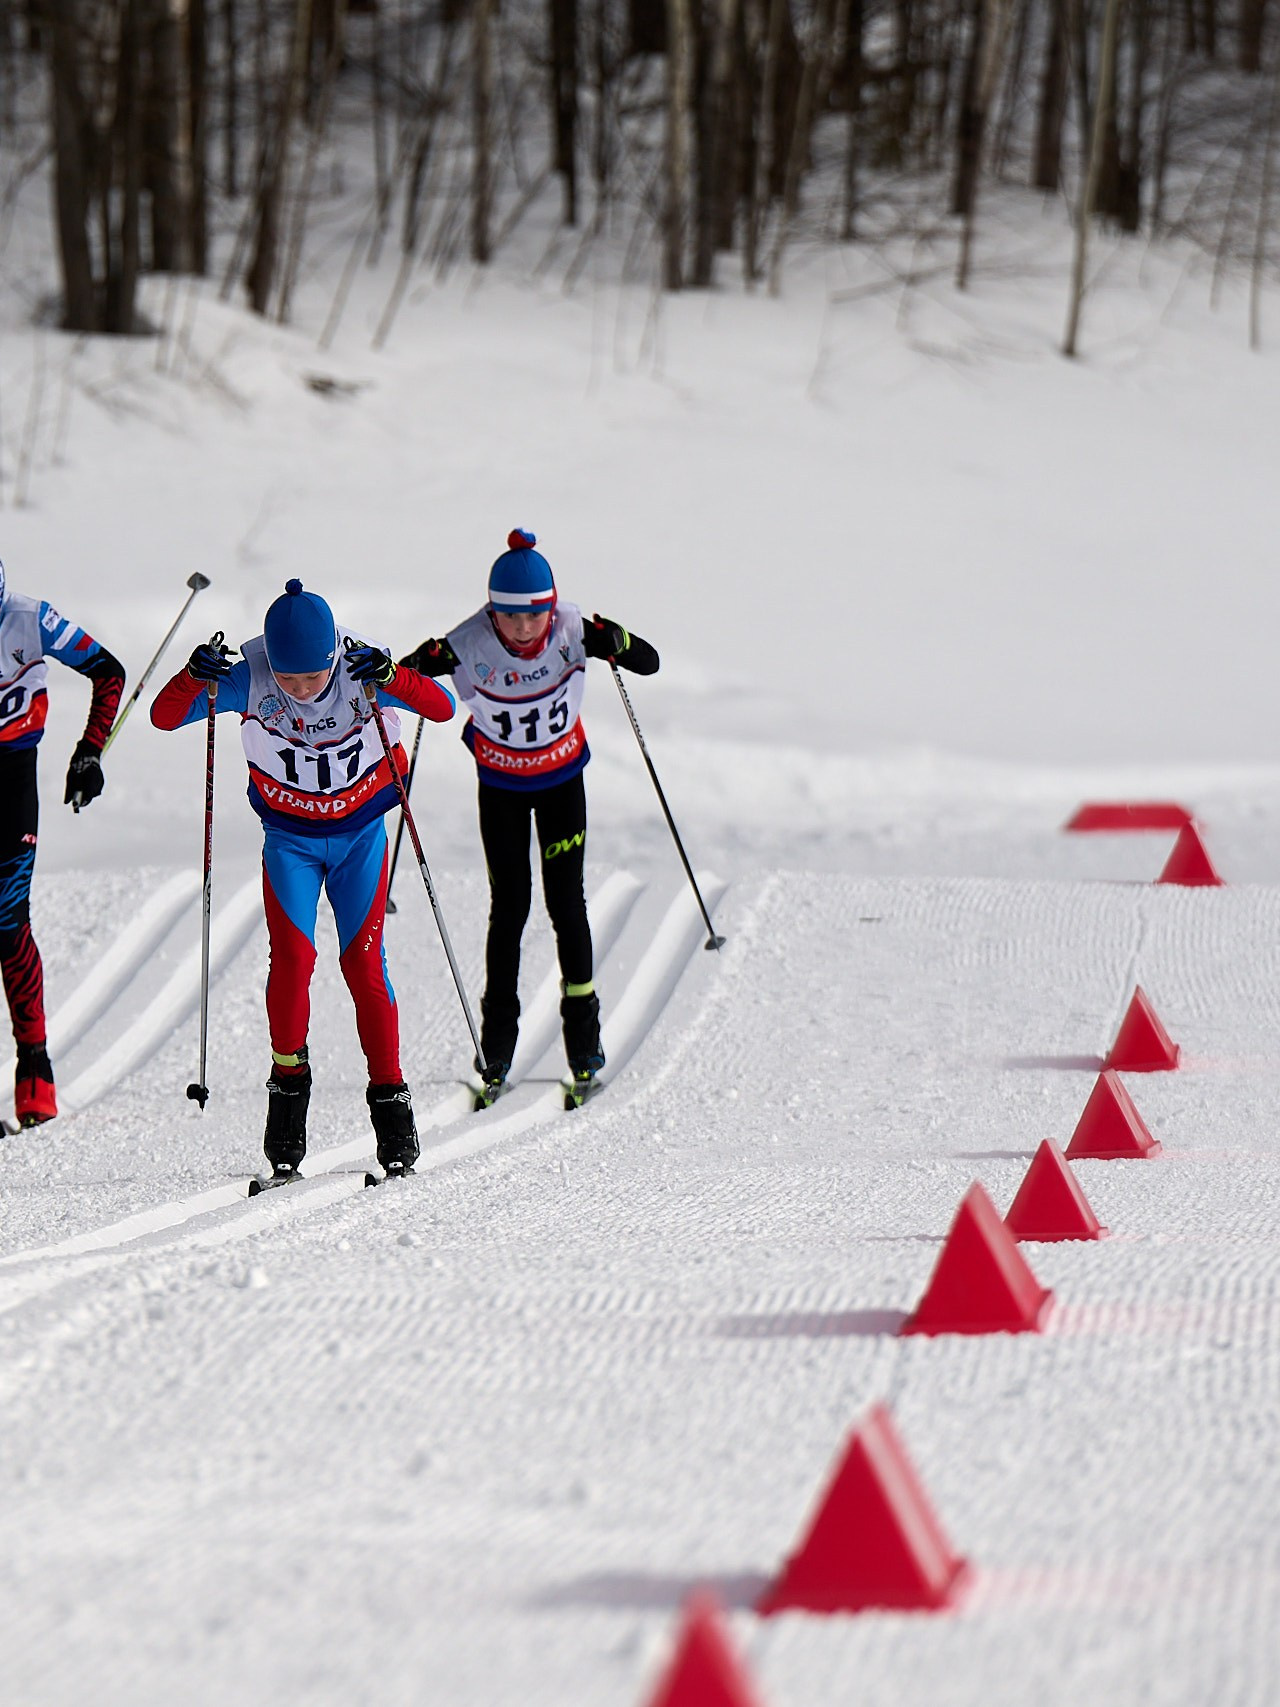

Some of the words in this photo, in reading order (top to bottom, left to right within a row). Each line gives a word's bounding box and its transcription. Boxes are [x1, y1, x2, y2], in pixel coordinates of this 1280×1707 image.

[522, 666, 549, 682] ПСБ
[306, 717, 337, 735] ПСБ
[492, 687, 568, 742] 115
[276, 738, 364, 791] 117
[545, 829, 585, 859] OW
